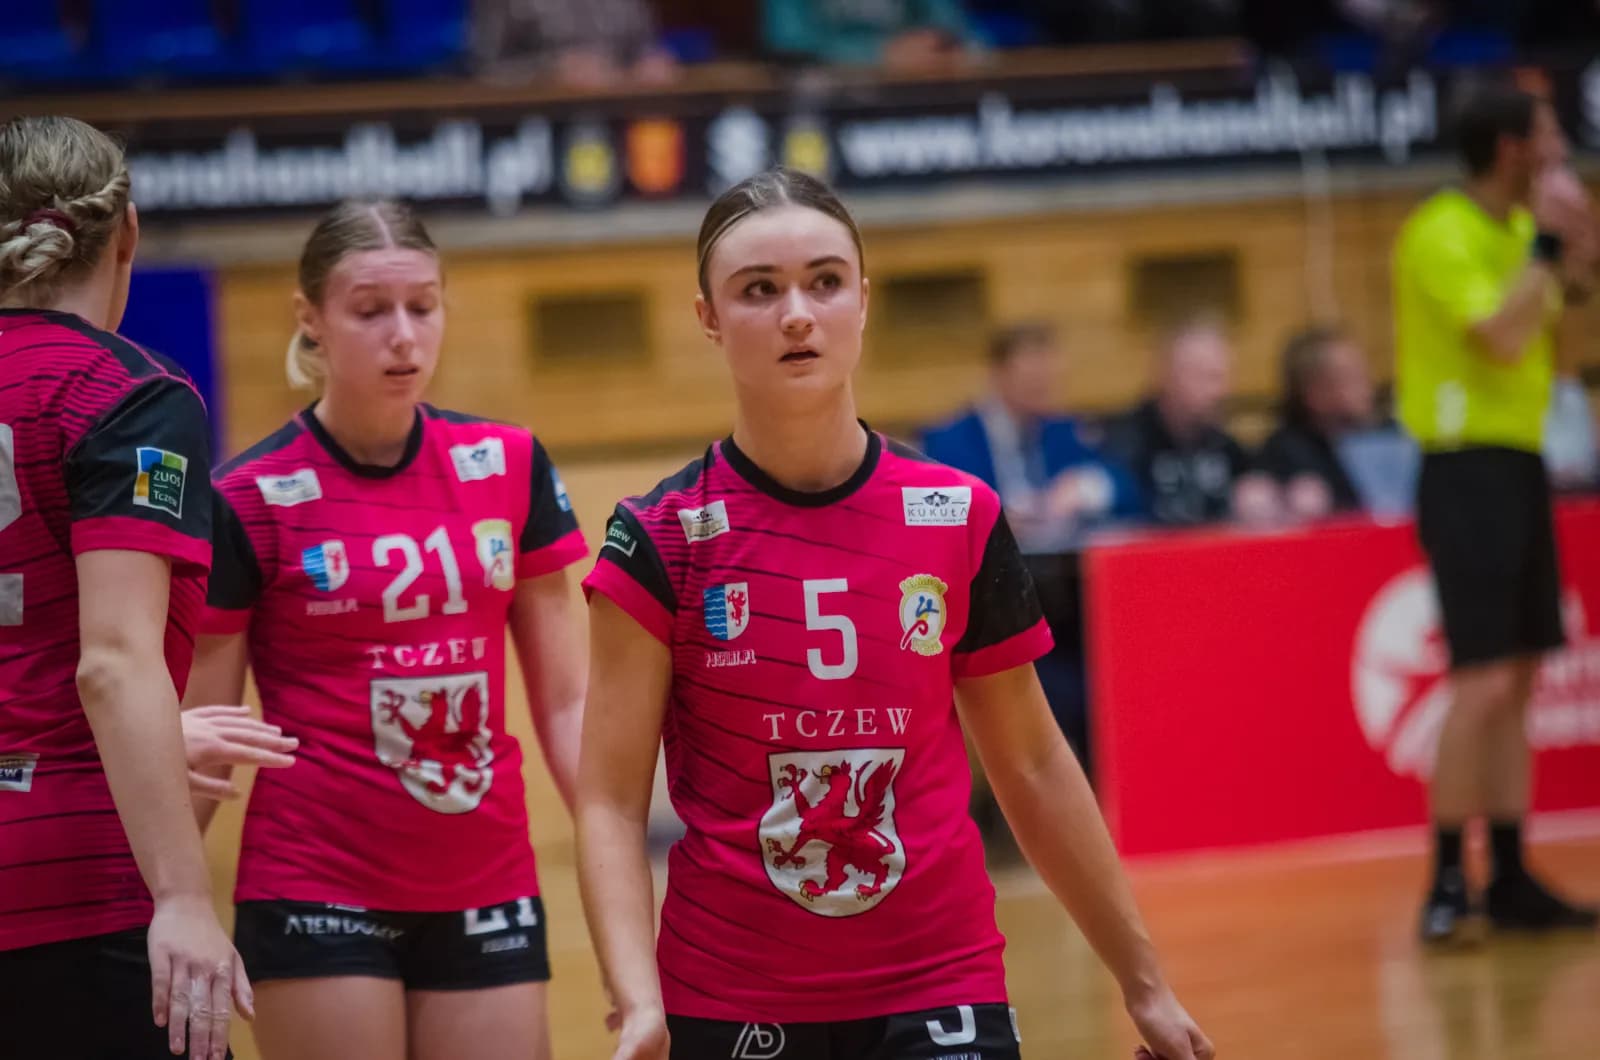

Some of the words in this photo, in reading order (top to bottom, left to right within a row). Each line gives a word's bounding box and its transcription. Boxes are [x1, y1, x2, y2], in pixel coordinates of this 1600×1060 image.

[371, 526, 468, 624] 21
[803, 578, 858, 680] 5
[763, 708, 913, 741] TCZEW
